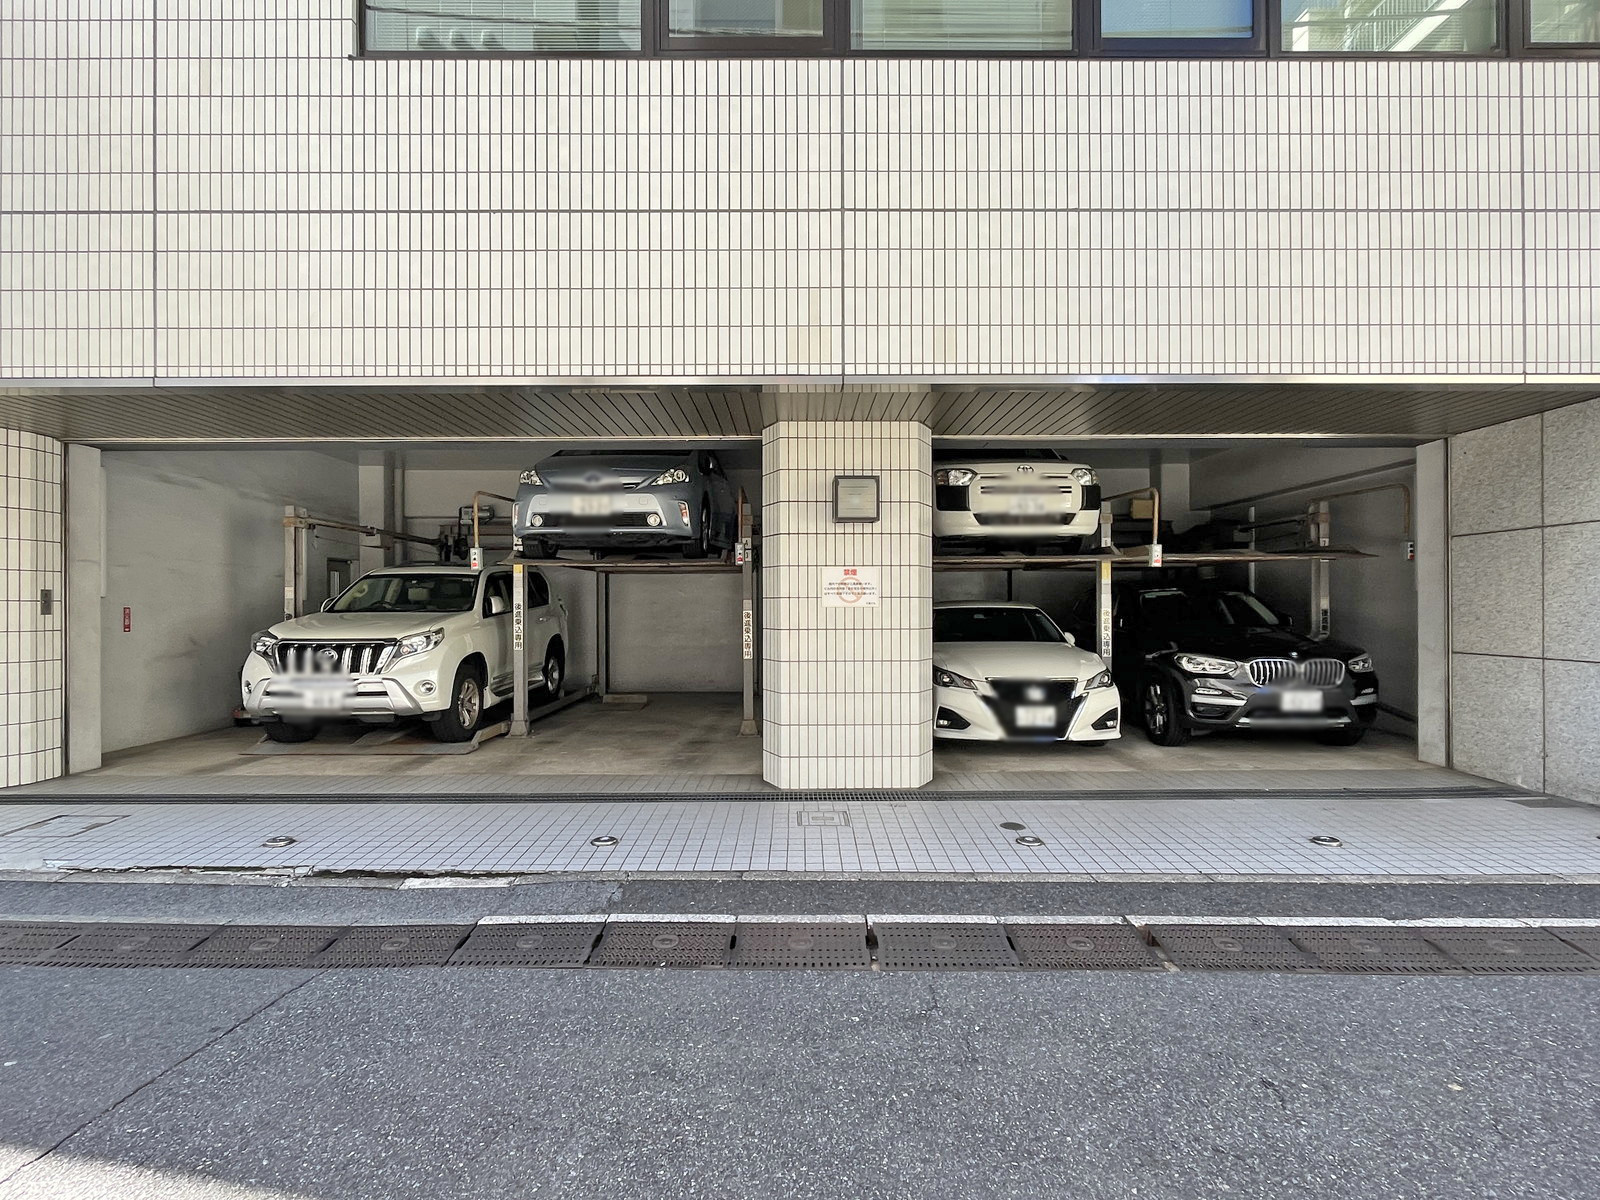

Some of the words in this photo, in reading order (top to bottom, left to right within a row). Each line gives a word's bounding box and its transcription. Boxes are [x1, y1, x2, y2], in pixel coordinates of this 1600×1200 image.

[743, 611, 752, 658] 後進乗込専用
[1103, 610, 1111, 656] 後進乗込専用
